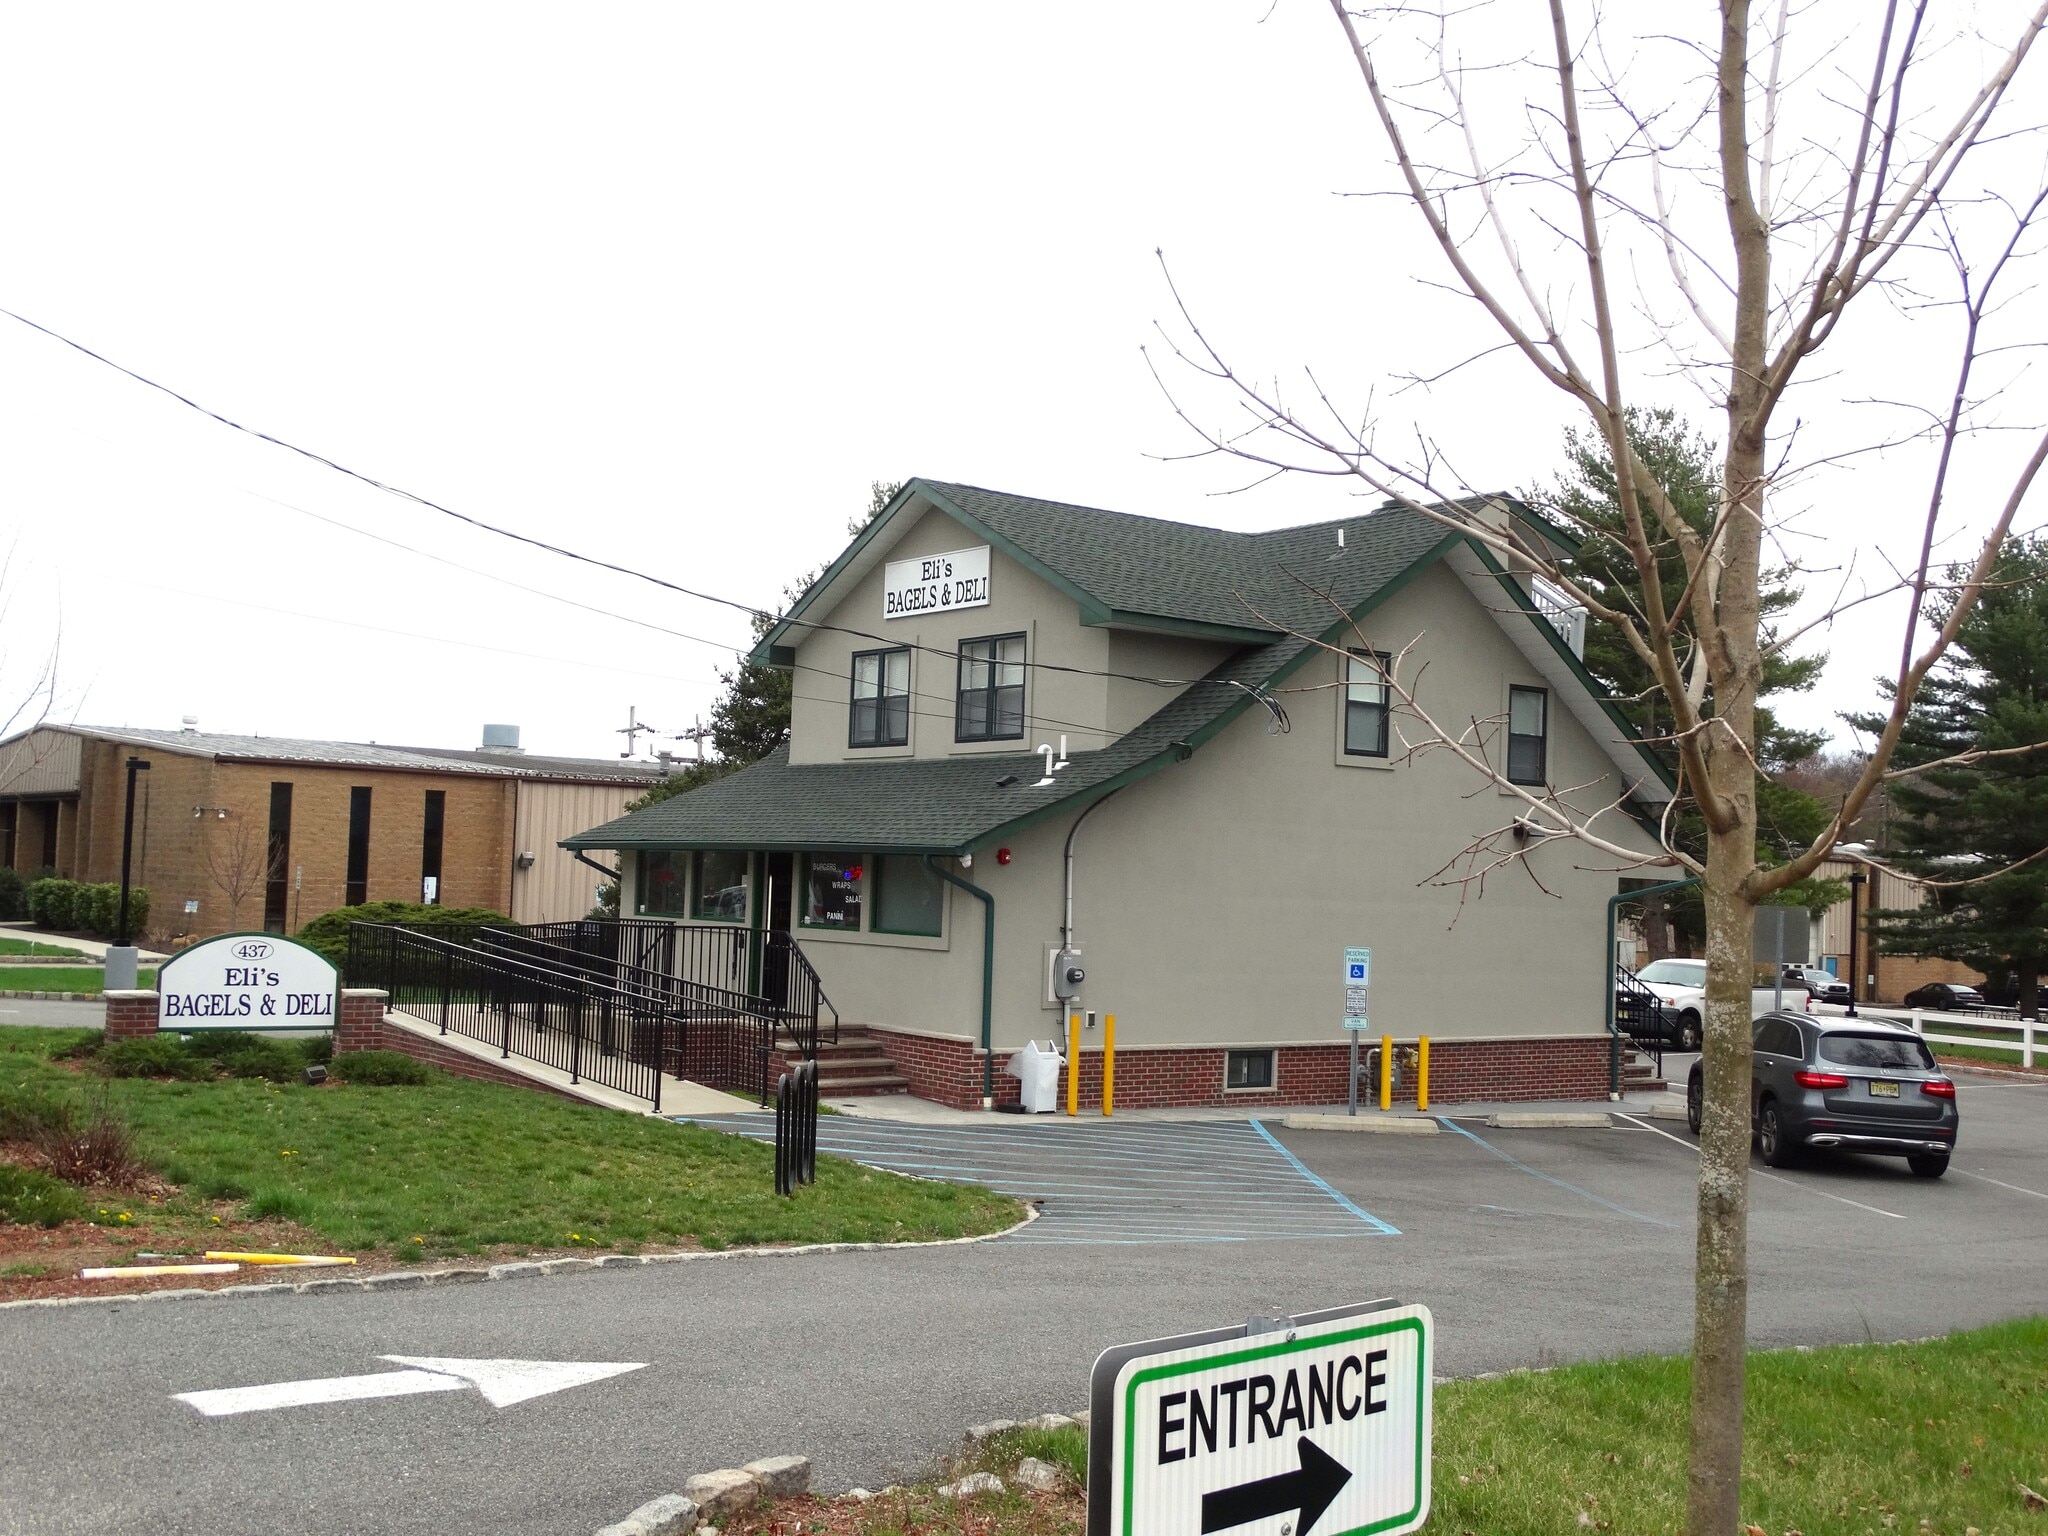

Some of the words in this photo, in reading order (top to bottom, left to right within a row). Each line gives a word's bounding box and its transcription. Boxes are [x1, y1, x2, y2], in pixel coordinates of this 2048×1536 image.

[921, 559, 953, 581] Eli's
[887, 585, 937, 614] BAGELS
[941, 583, 952, 606] &
[955, 577, 987, 604] DELI
[832, 881, 851, 890] WRAPS
[238, 945, 268, 958] 437
[224, 967, 280, 987] Eli's
[165, 994, 251, 1017] BAGELS
[260, 993, 276, 1016] &
[285, 993, 333, 1016] DELI
[1158, 1349, 1388, 1466] ENTRANCE
